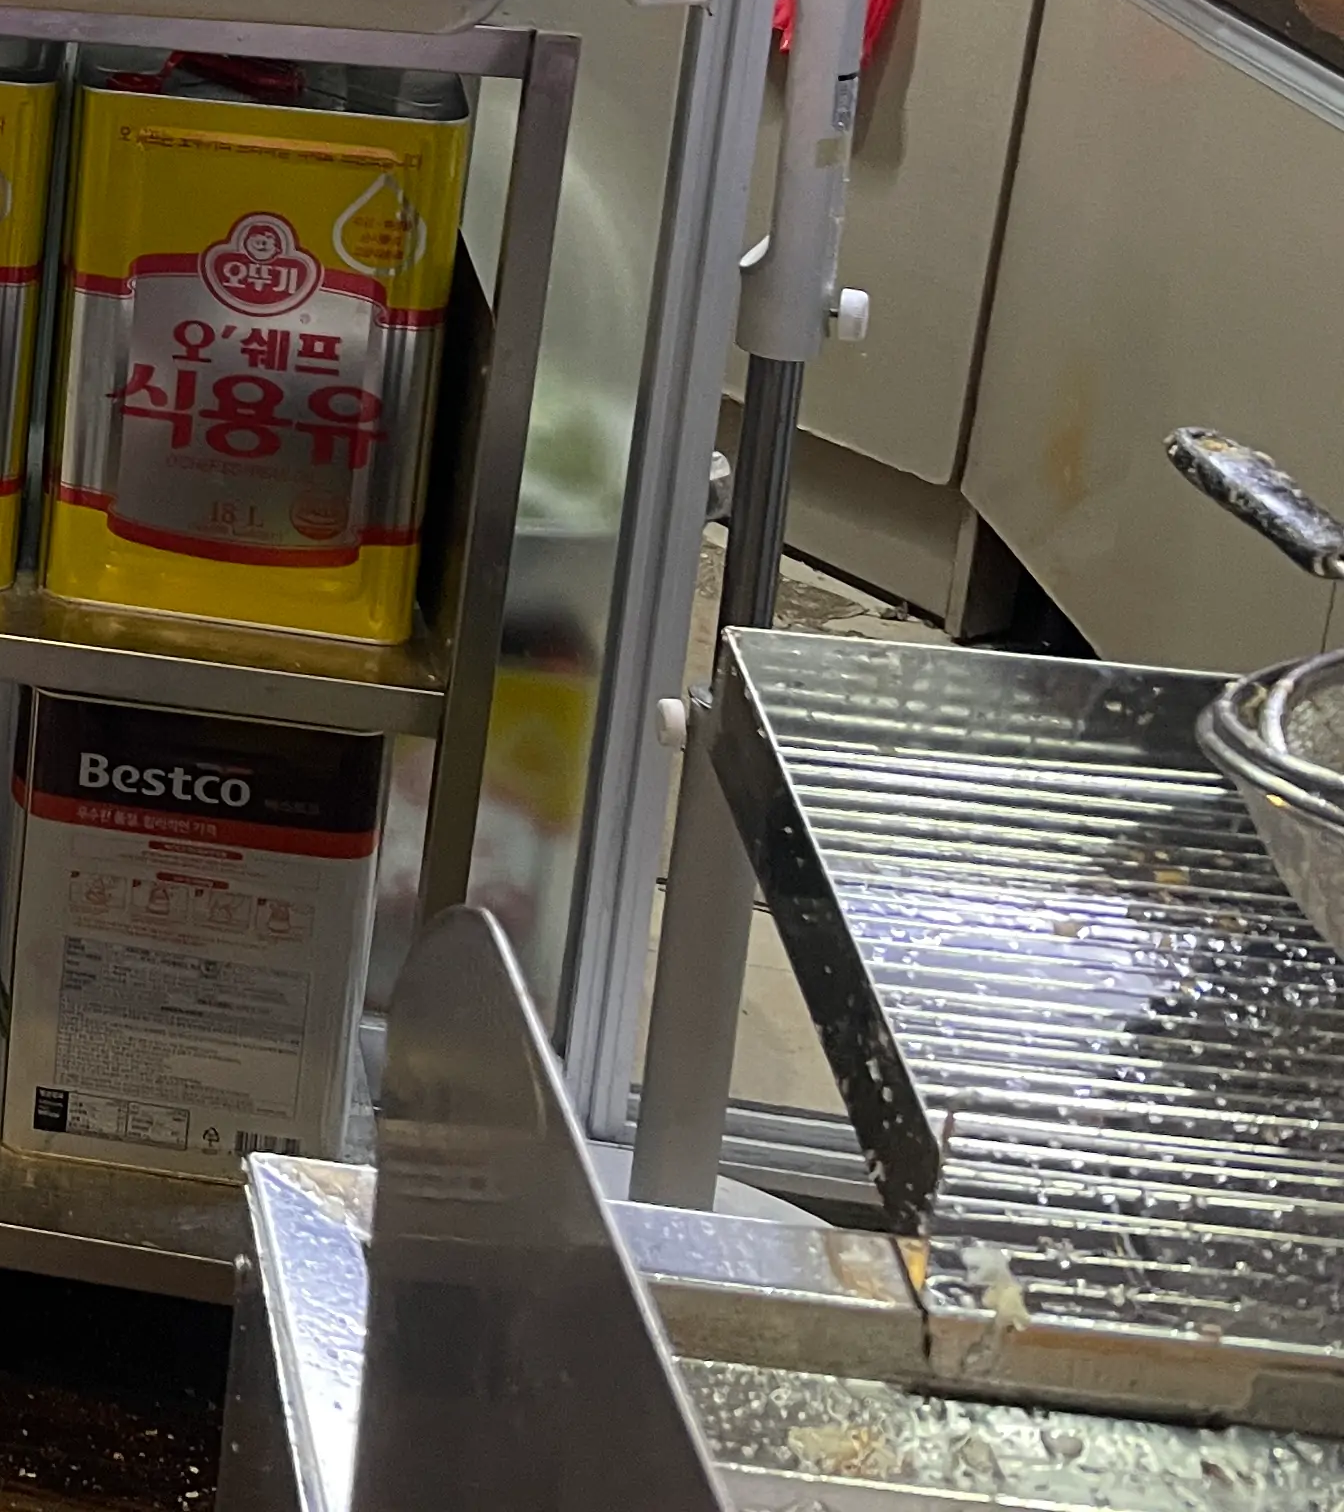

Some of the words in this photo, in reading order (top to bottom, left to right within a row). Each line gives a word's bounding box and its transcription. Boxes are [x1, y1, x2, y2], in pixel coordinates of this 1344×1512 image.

[222, 258, 298, 295] 오뚜기
[121, 362, 389, 468] 식용유
[247, 505, 264, 528] L
[78, 752, 251, 808] Bestco
